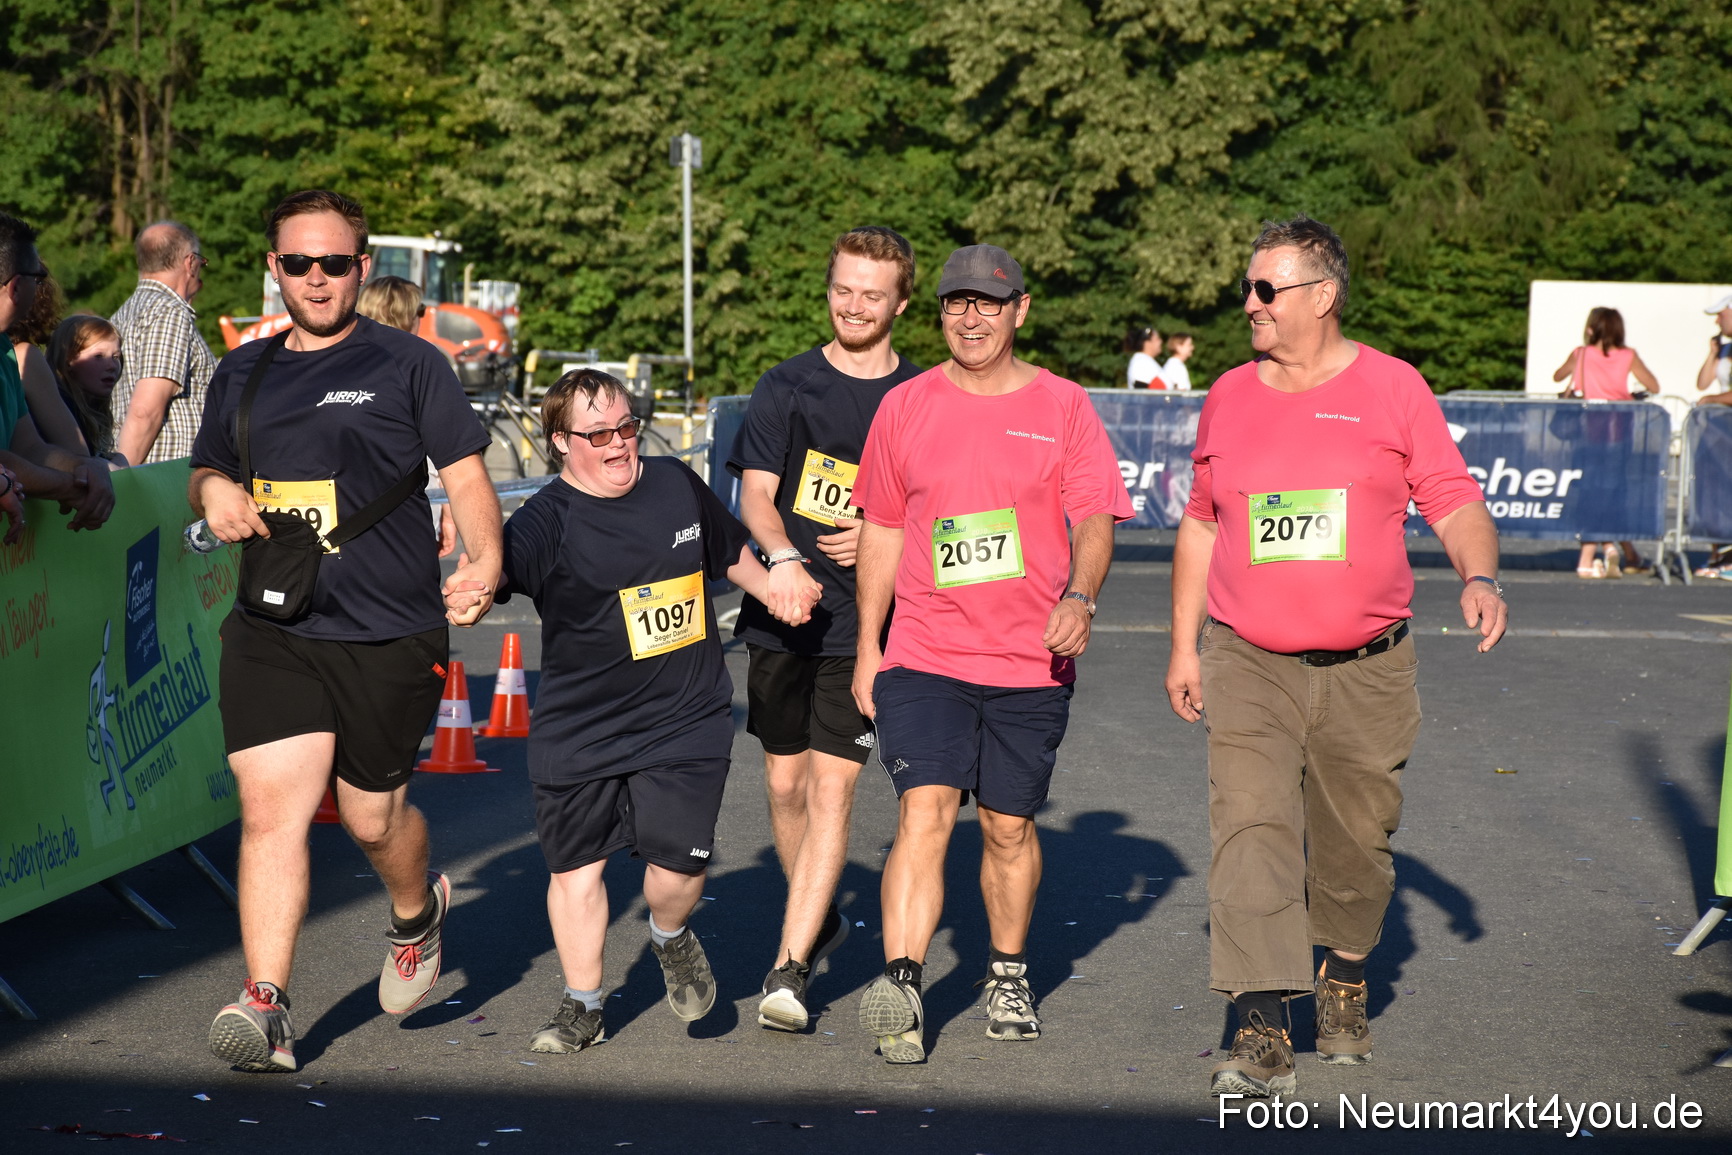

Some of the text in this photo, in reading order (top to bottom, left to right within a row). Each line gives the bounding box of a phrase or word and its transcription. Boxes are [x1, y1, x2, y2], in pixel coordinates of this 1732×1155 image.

[316, 391, 359, 407] JURA
[1315, 412, 1361, 423] Richard Herold
[1005, 429, 1056, 443] Joachim Simbeck
[819, 504, 836, 515] Benz
[672, 526, 696, 549] JURA
[1260, 514, 1333, 543] 2079
[940, 534, 1007, 568] 2057
[637, 598, 696, 636] 1097
[654, 627, 689, 642] Seger Daniel
[114, 622, 211, 764] firmenlauf
[134, 741, 177, 797] neumarkt
[690, 847, 710, 859] JAKO
